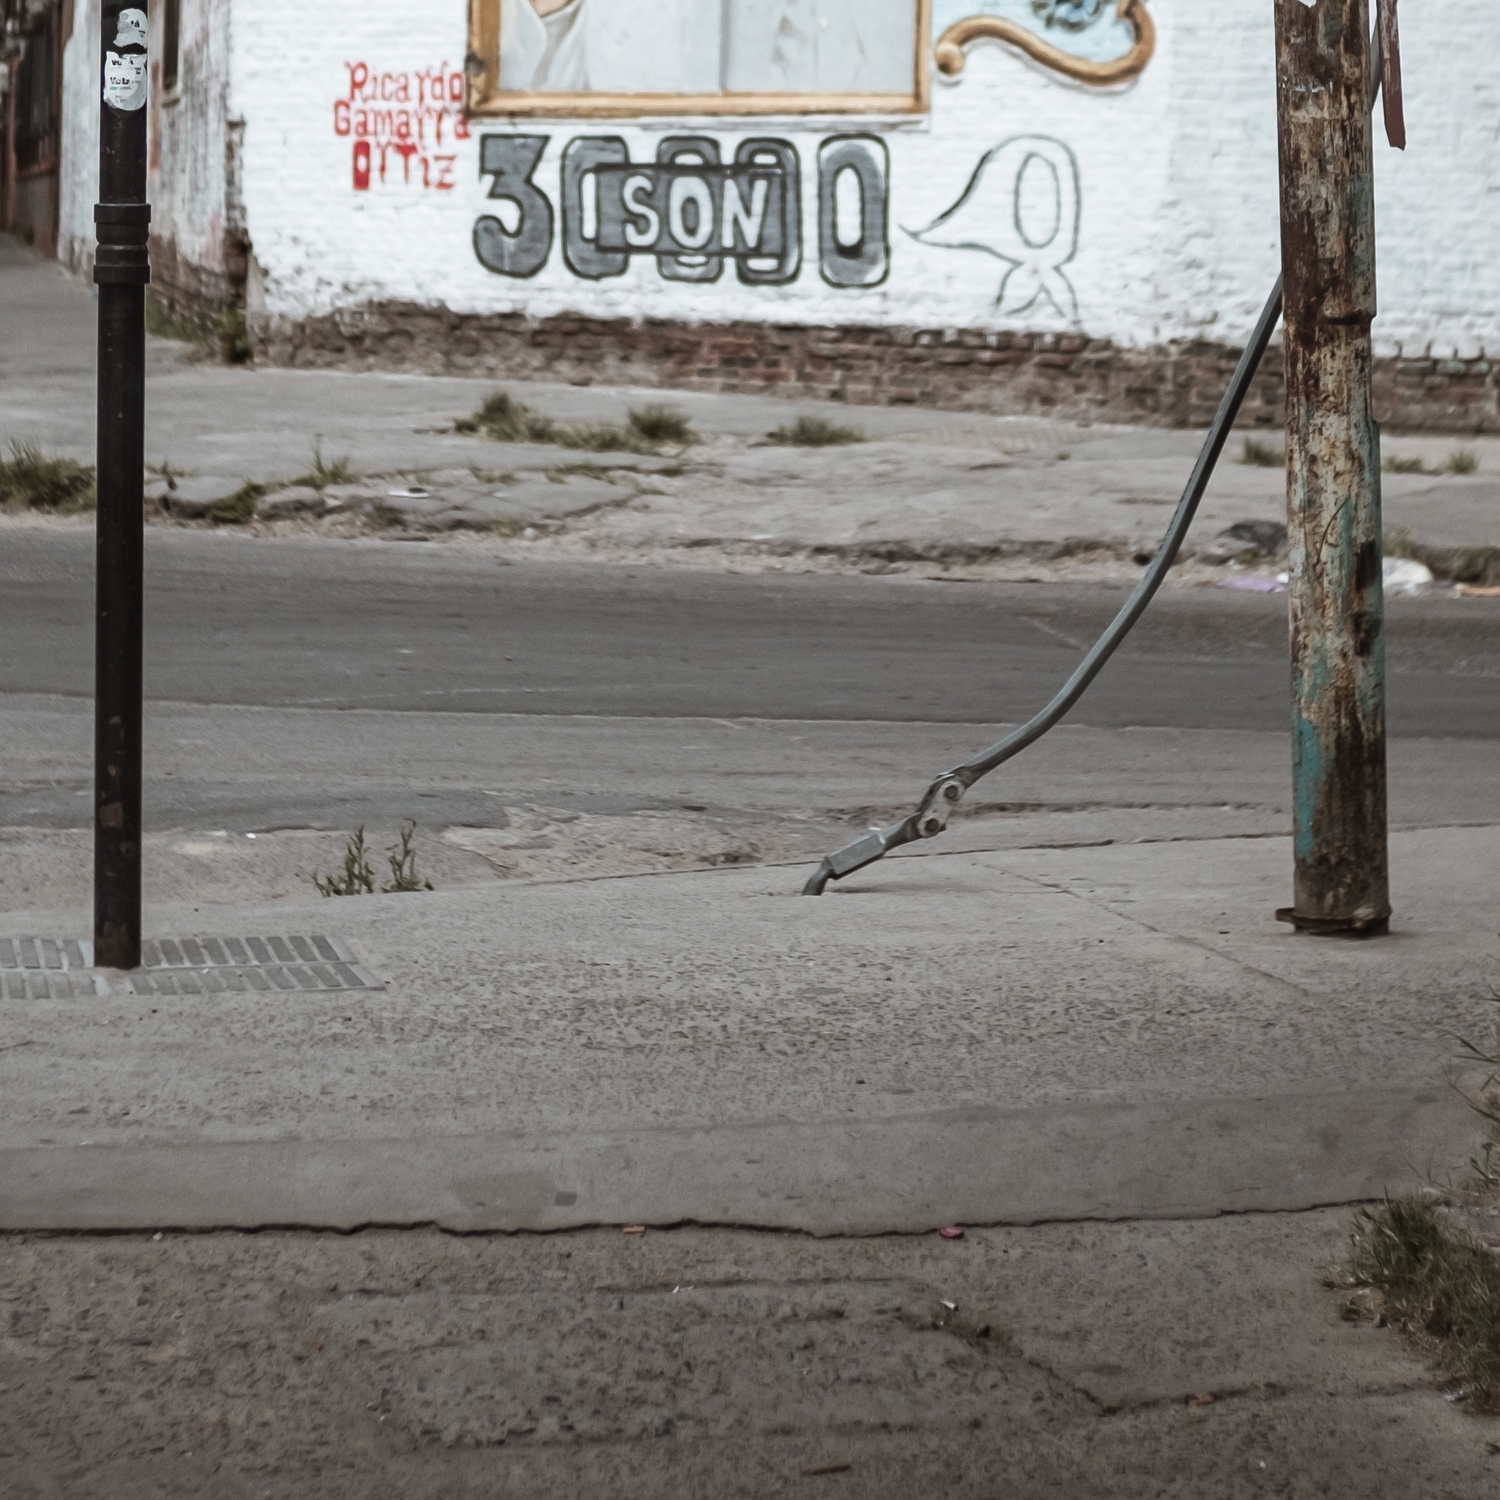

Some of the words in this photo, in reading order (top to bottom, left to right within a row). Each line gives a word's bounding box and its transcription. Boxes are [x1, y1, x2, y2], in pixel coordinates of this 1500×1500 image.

[344, 60, 467, 108] Ricardo
[333, 98, 472, 148] Gamarra
[622, 173, 769, 251] SON
